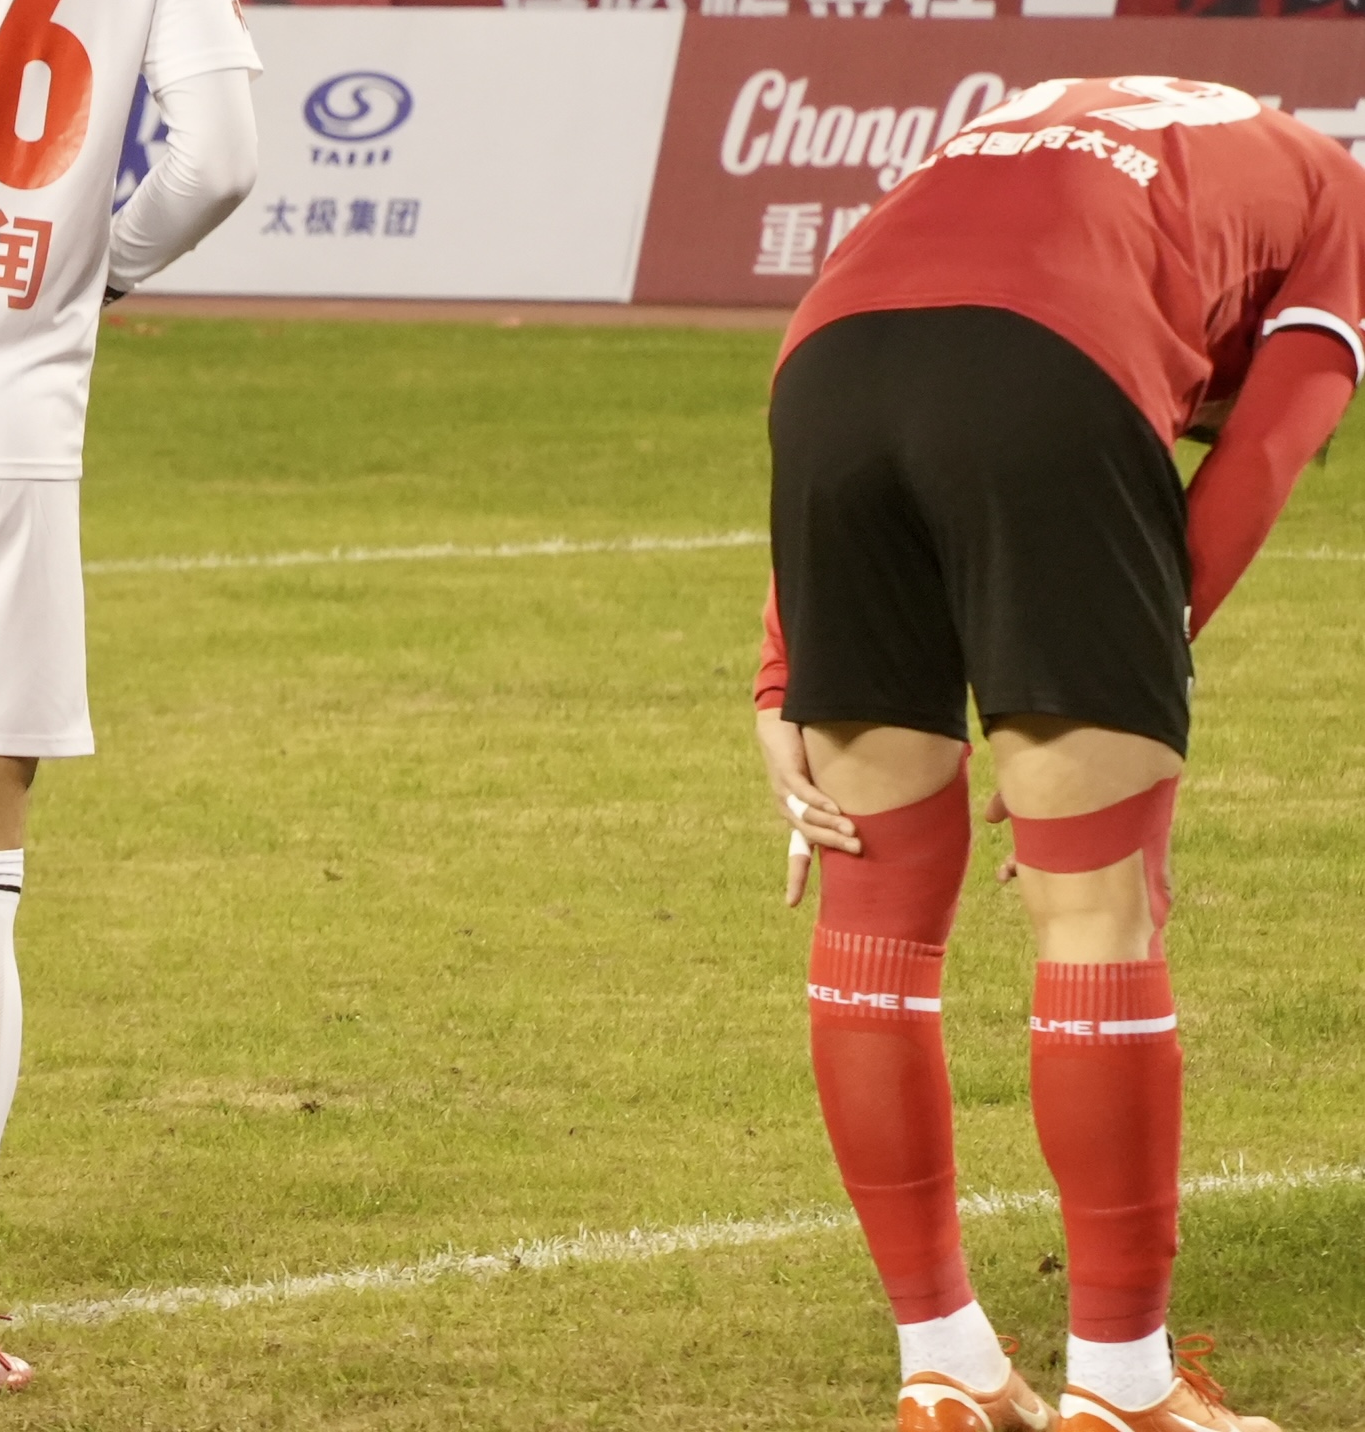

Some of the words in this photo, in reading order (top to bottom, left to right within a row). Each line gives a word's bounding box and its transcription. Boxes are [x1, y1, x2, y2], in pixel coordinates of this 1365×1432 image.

[261, 197, 421, 237] 太极集团
[806, 982, 900, 1010] KELME
